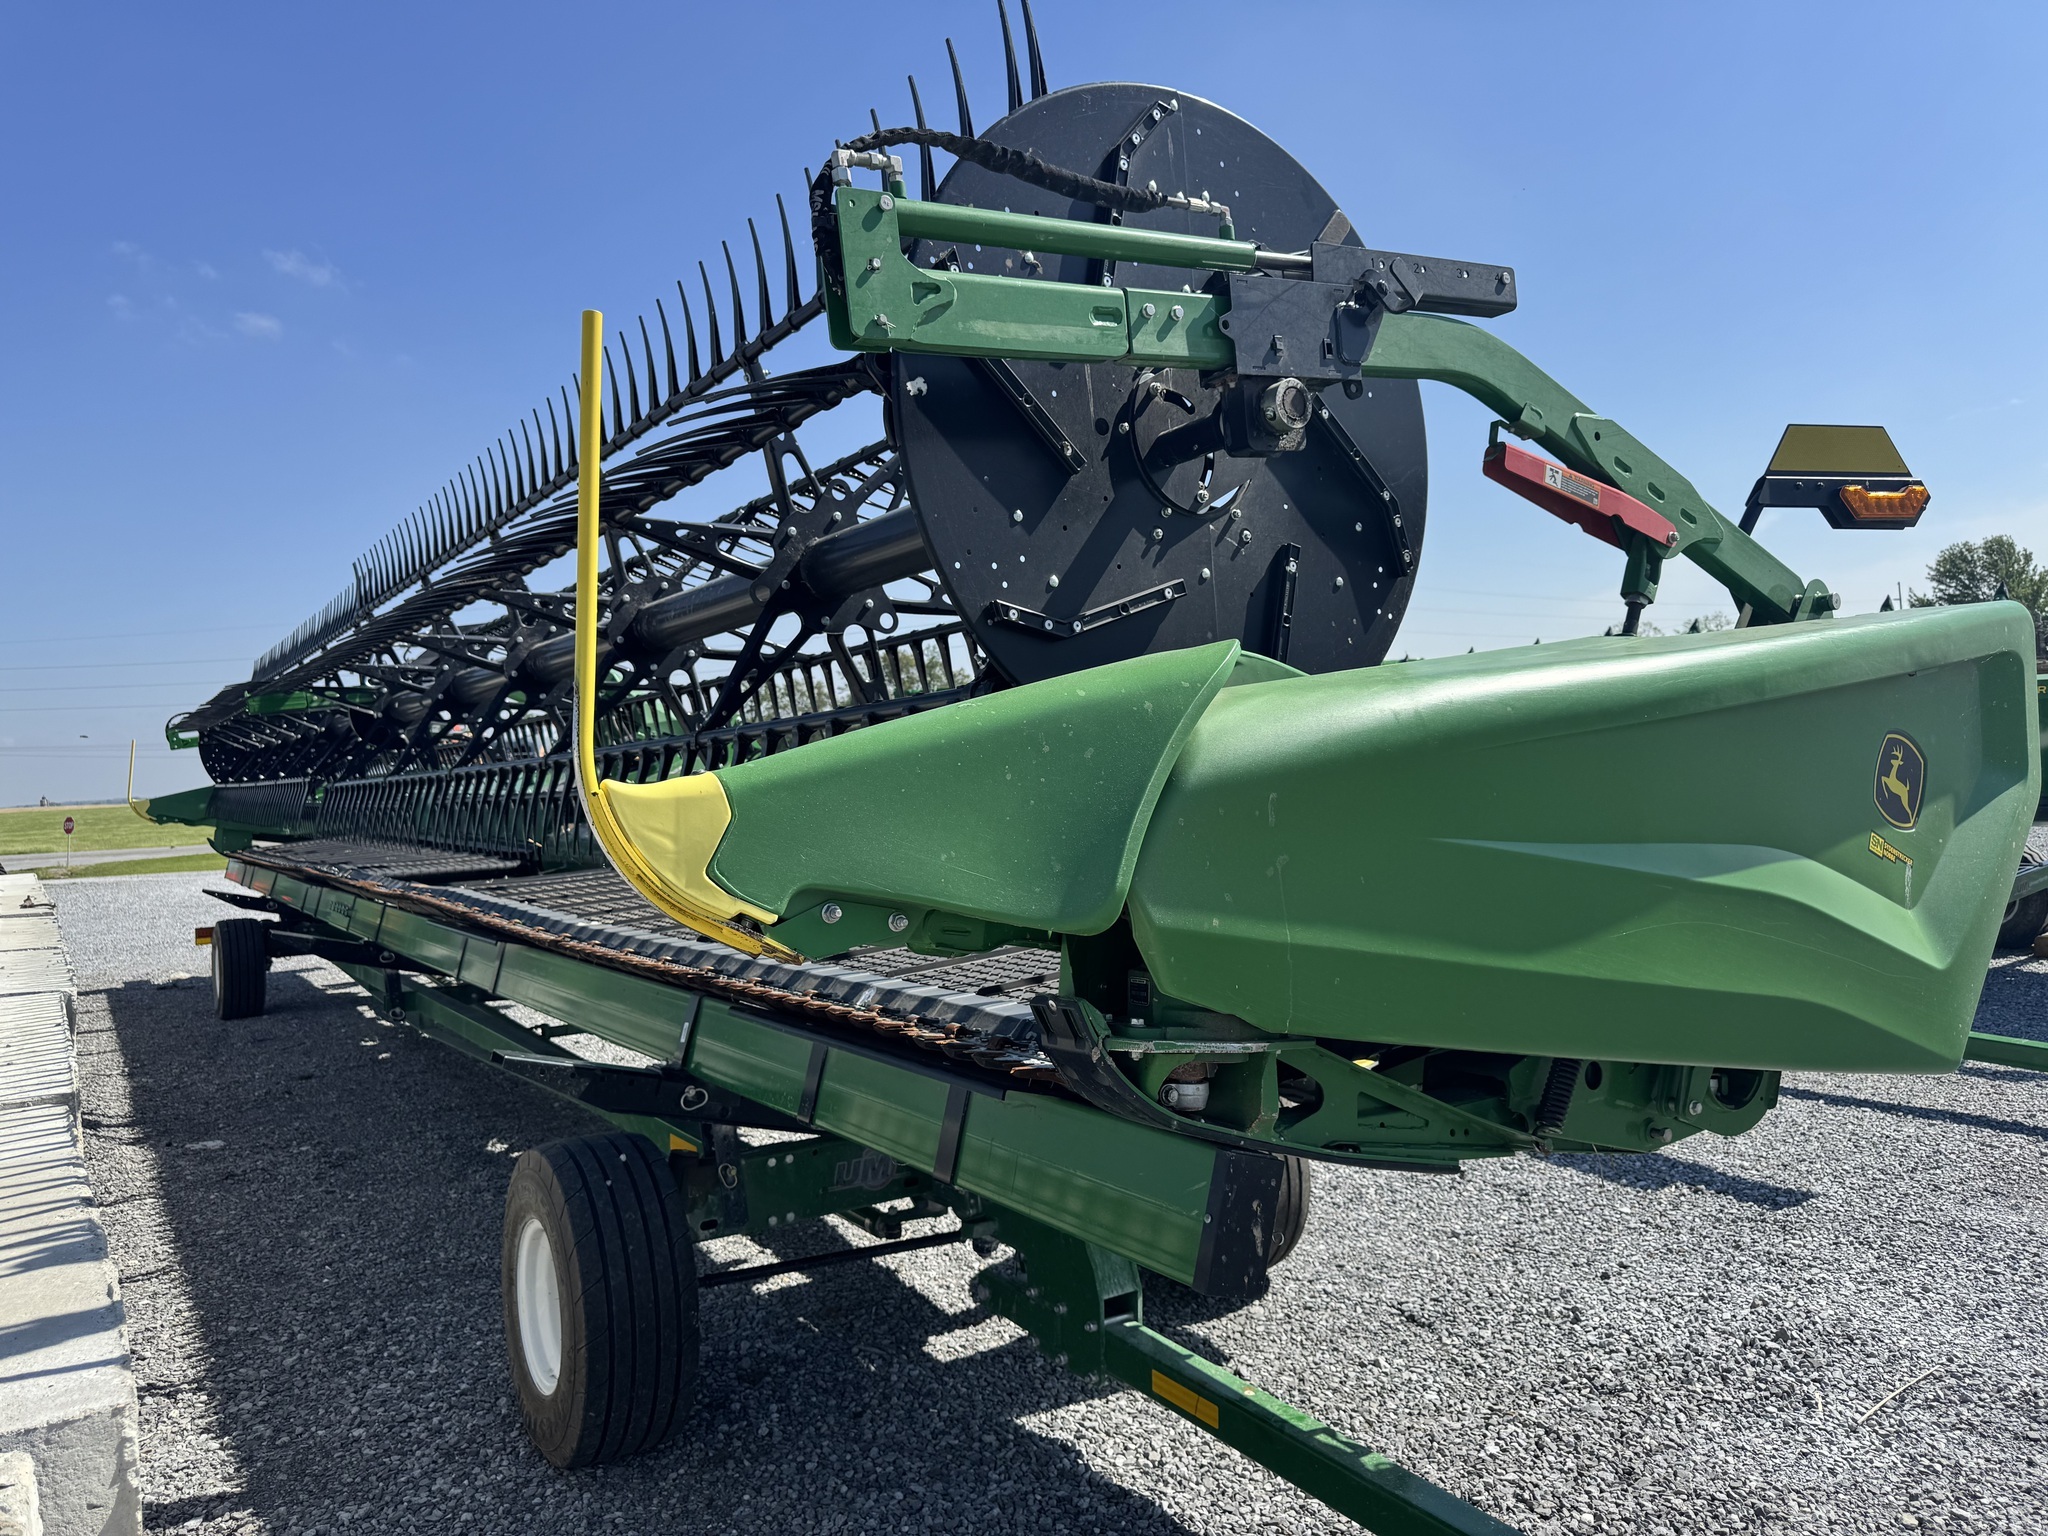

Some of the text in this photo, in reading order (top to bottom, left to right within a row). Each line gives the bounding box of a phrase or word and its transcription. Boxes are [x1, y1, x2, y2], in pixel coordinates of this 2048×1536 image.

[1370, 257, 1375, 268] 1
[1413, 263, 1420, 274] 2
[1456, 268, 1463, 279] 3
